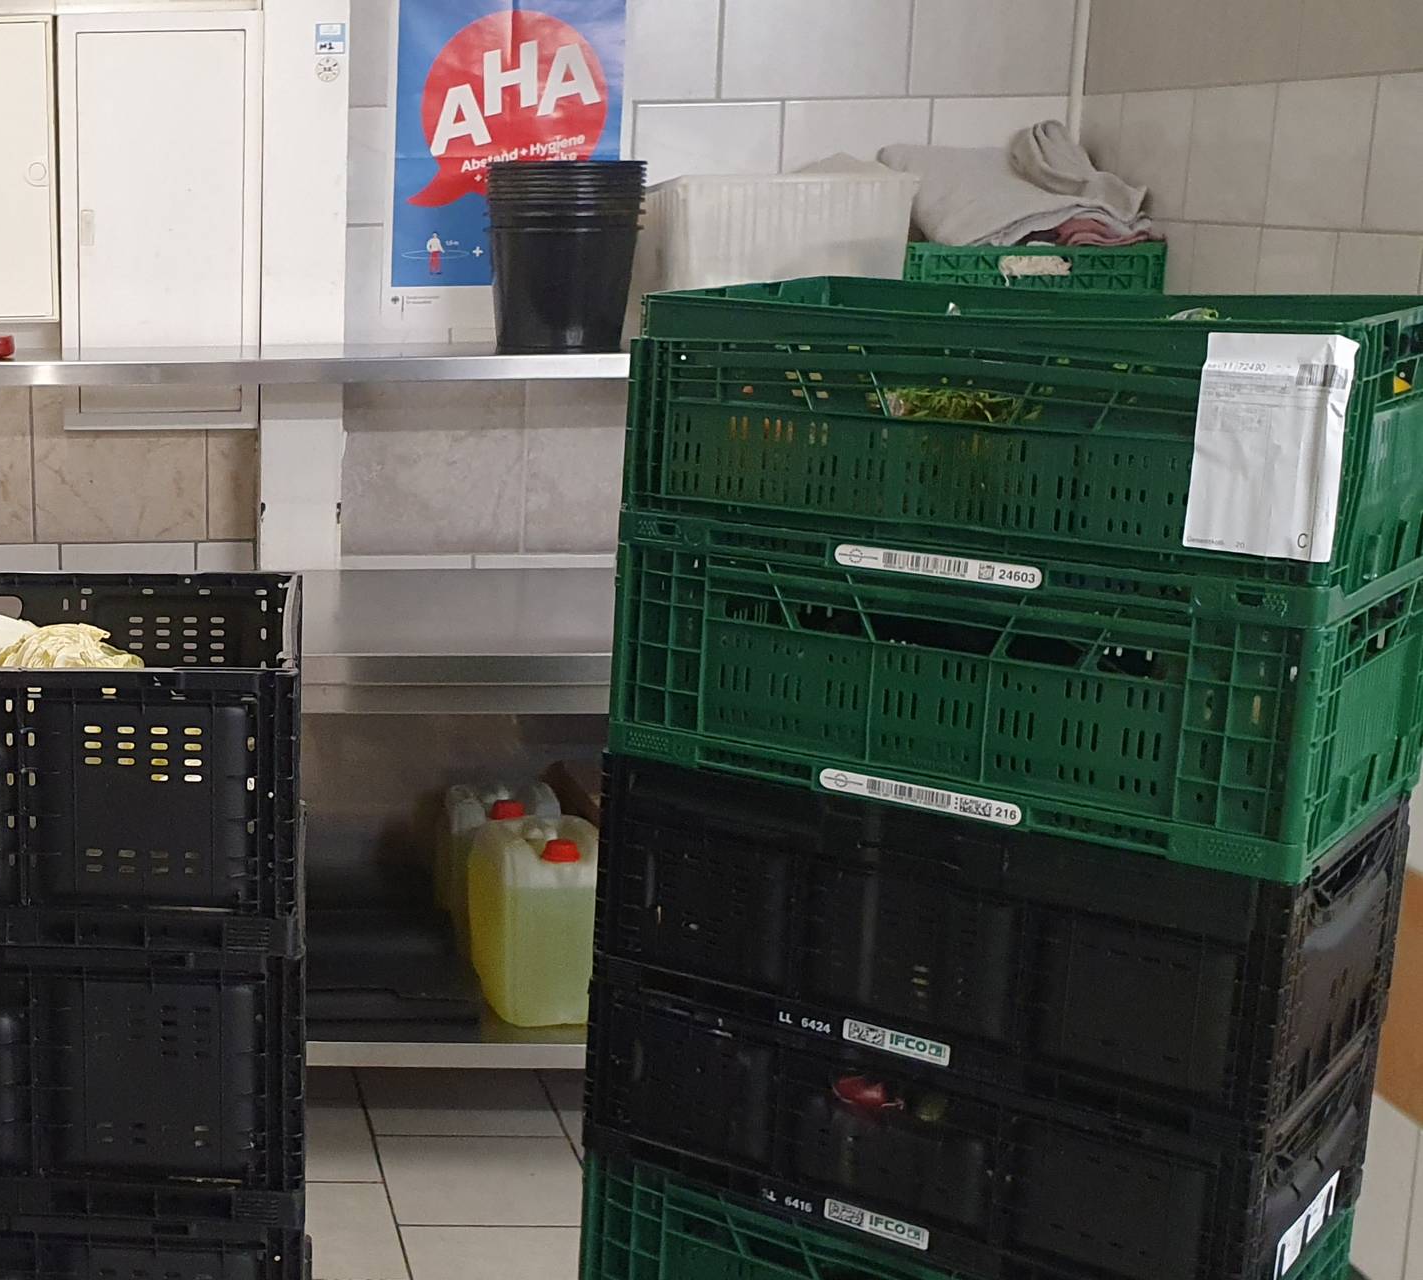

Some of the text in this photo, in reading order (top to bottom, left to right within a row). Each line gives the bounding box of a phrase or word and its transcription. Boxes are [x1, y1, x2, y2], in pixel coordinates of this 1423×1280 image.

[430, 40, 601, 157] AHA
[461, 147, 518, 173] Abstand
[529, 134, 586, 156] Hygiene
[1297, 533, 1309, 549] C
[998, 568, 1036, 584] 24603
[994, 806, 1017, 821] 216
[779, 1011, 831, 1034] LL 6424
[889, 1033, 927, 1053] IFCO
[785, 1195, 813, 1213] 6416
[869, 1214, 907, 1236] IFCO
